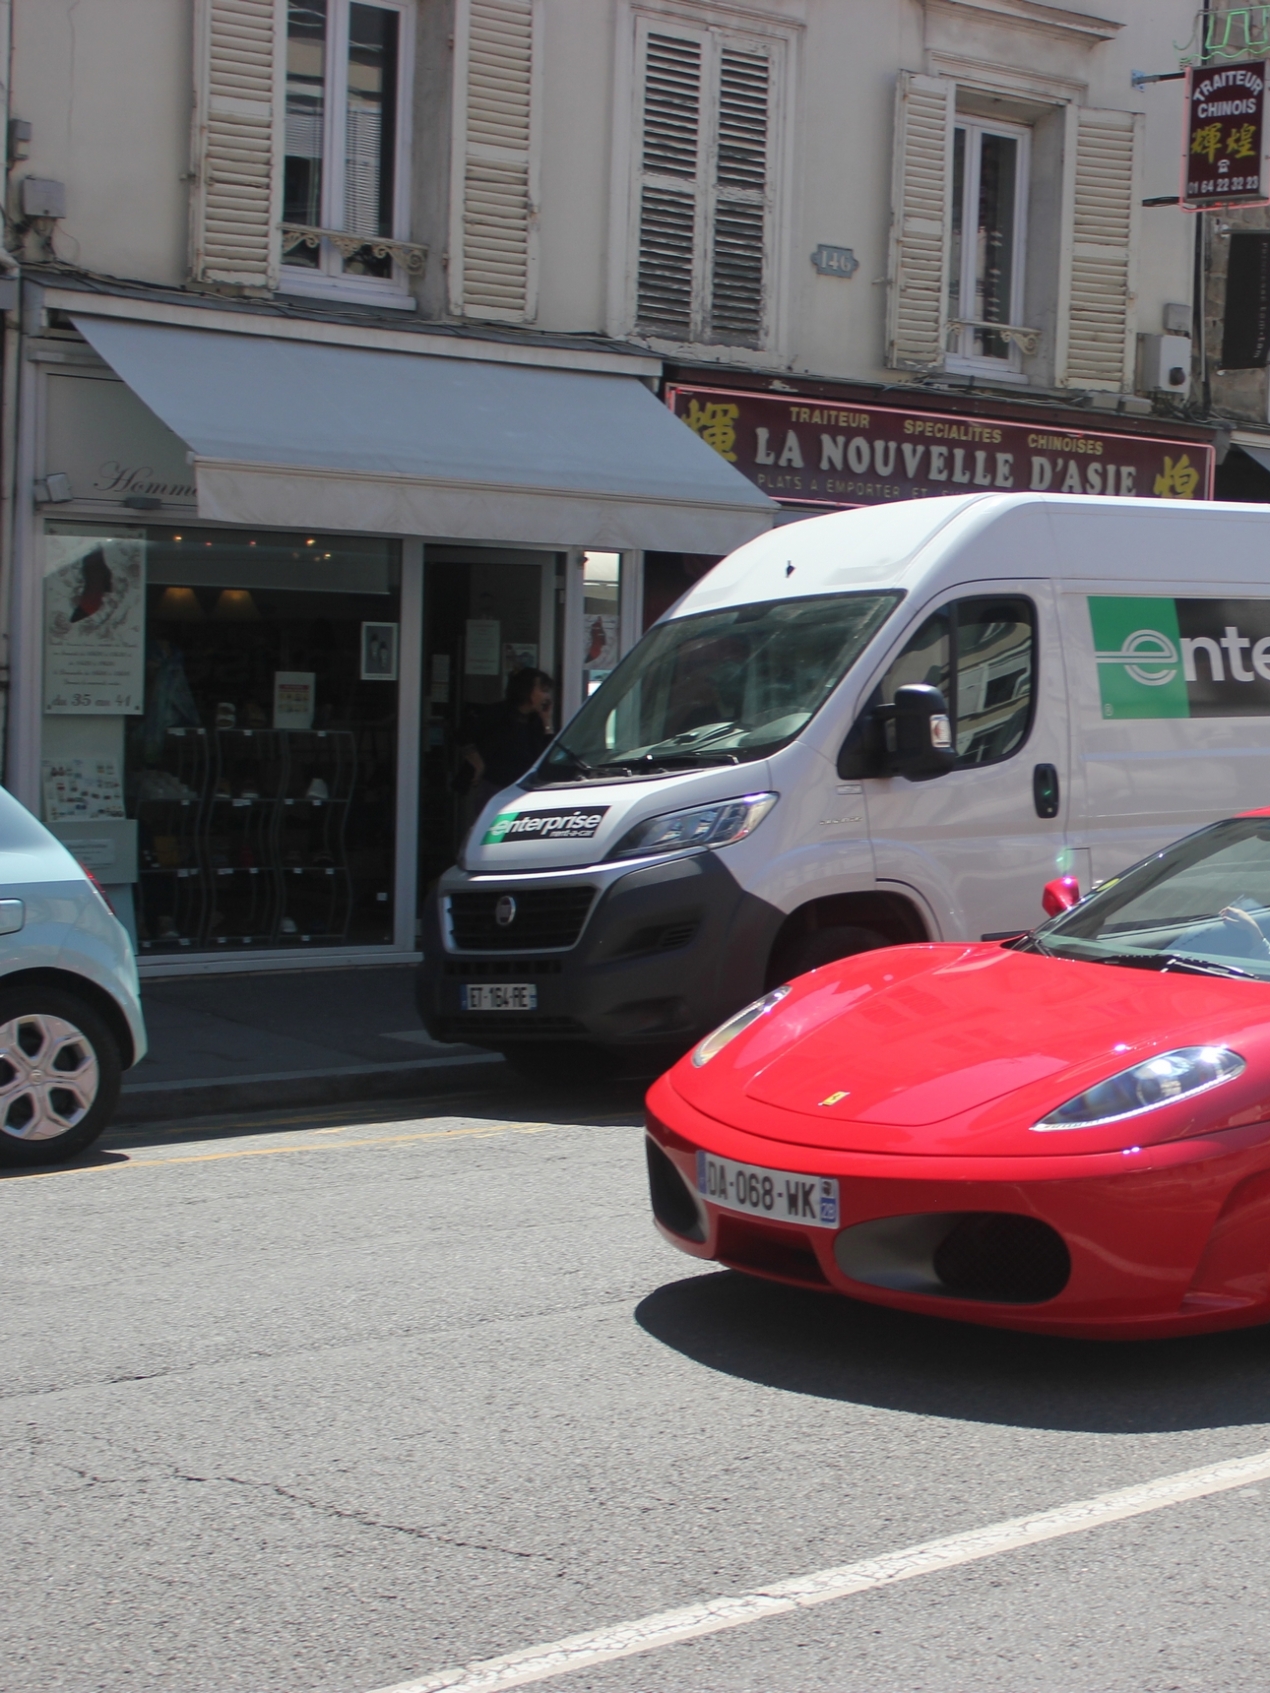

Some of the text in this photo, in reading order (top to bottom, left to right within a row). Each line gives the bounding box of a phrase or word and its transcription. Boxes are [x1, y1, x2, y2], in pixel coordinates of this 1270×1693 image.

[1193, 70, 1263, 102] TRAITEUR
[1197, 98, 1257, 119] CHINOIS
[1188, 175, 1259, 194] 01 64 22 32 23
[821, 250, 851, 272] 146
[790, 406, 1104, 456] TRAITEUR SPECIALITES CHINOISES
[755, 426, 1137, 497] LA NOUVELLE D'ASIE
[757, 473, 803, 490] PLATS
[810, 480, 819, 491] A
[826, 479, 901, 499] EMPORTER
[71, 693, 92, 707] 35
[490, 811, 602, 836] enterprise
[549, 829, 595, 838] rent-a-car
[708, 1161, 817, 1219] DA-068-WK
